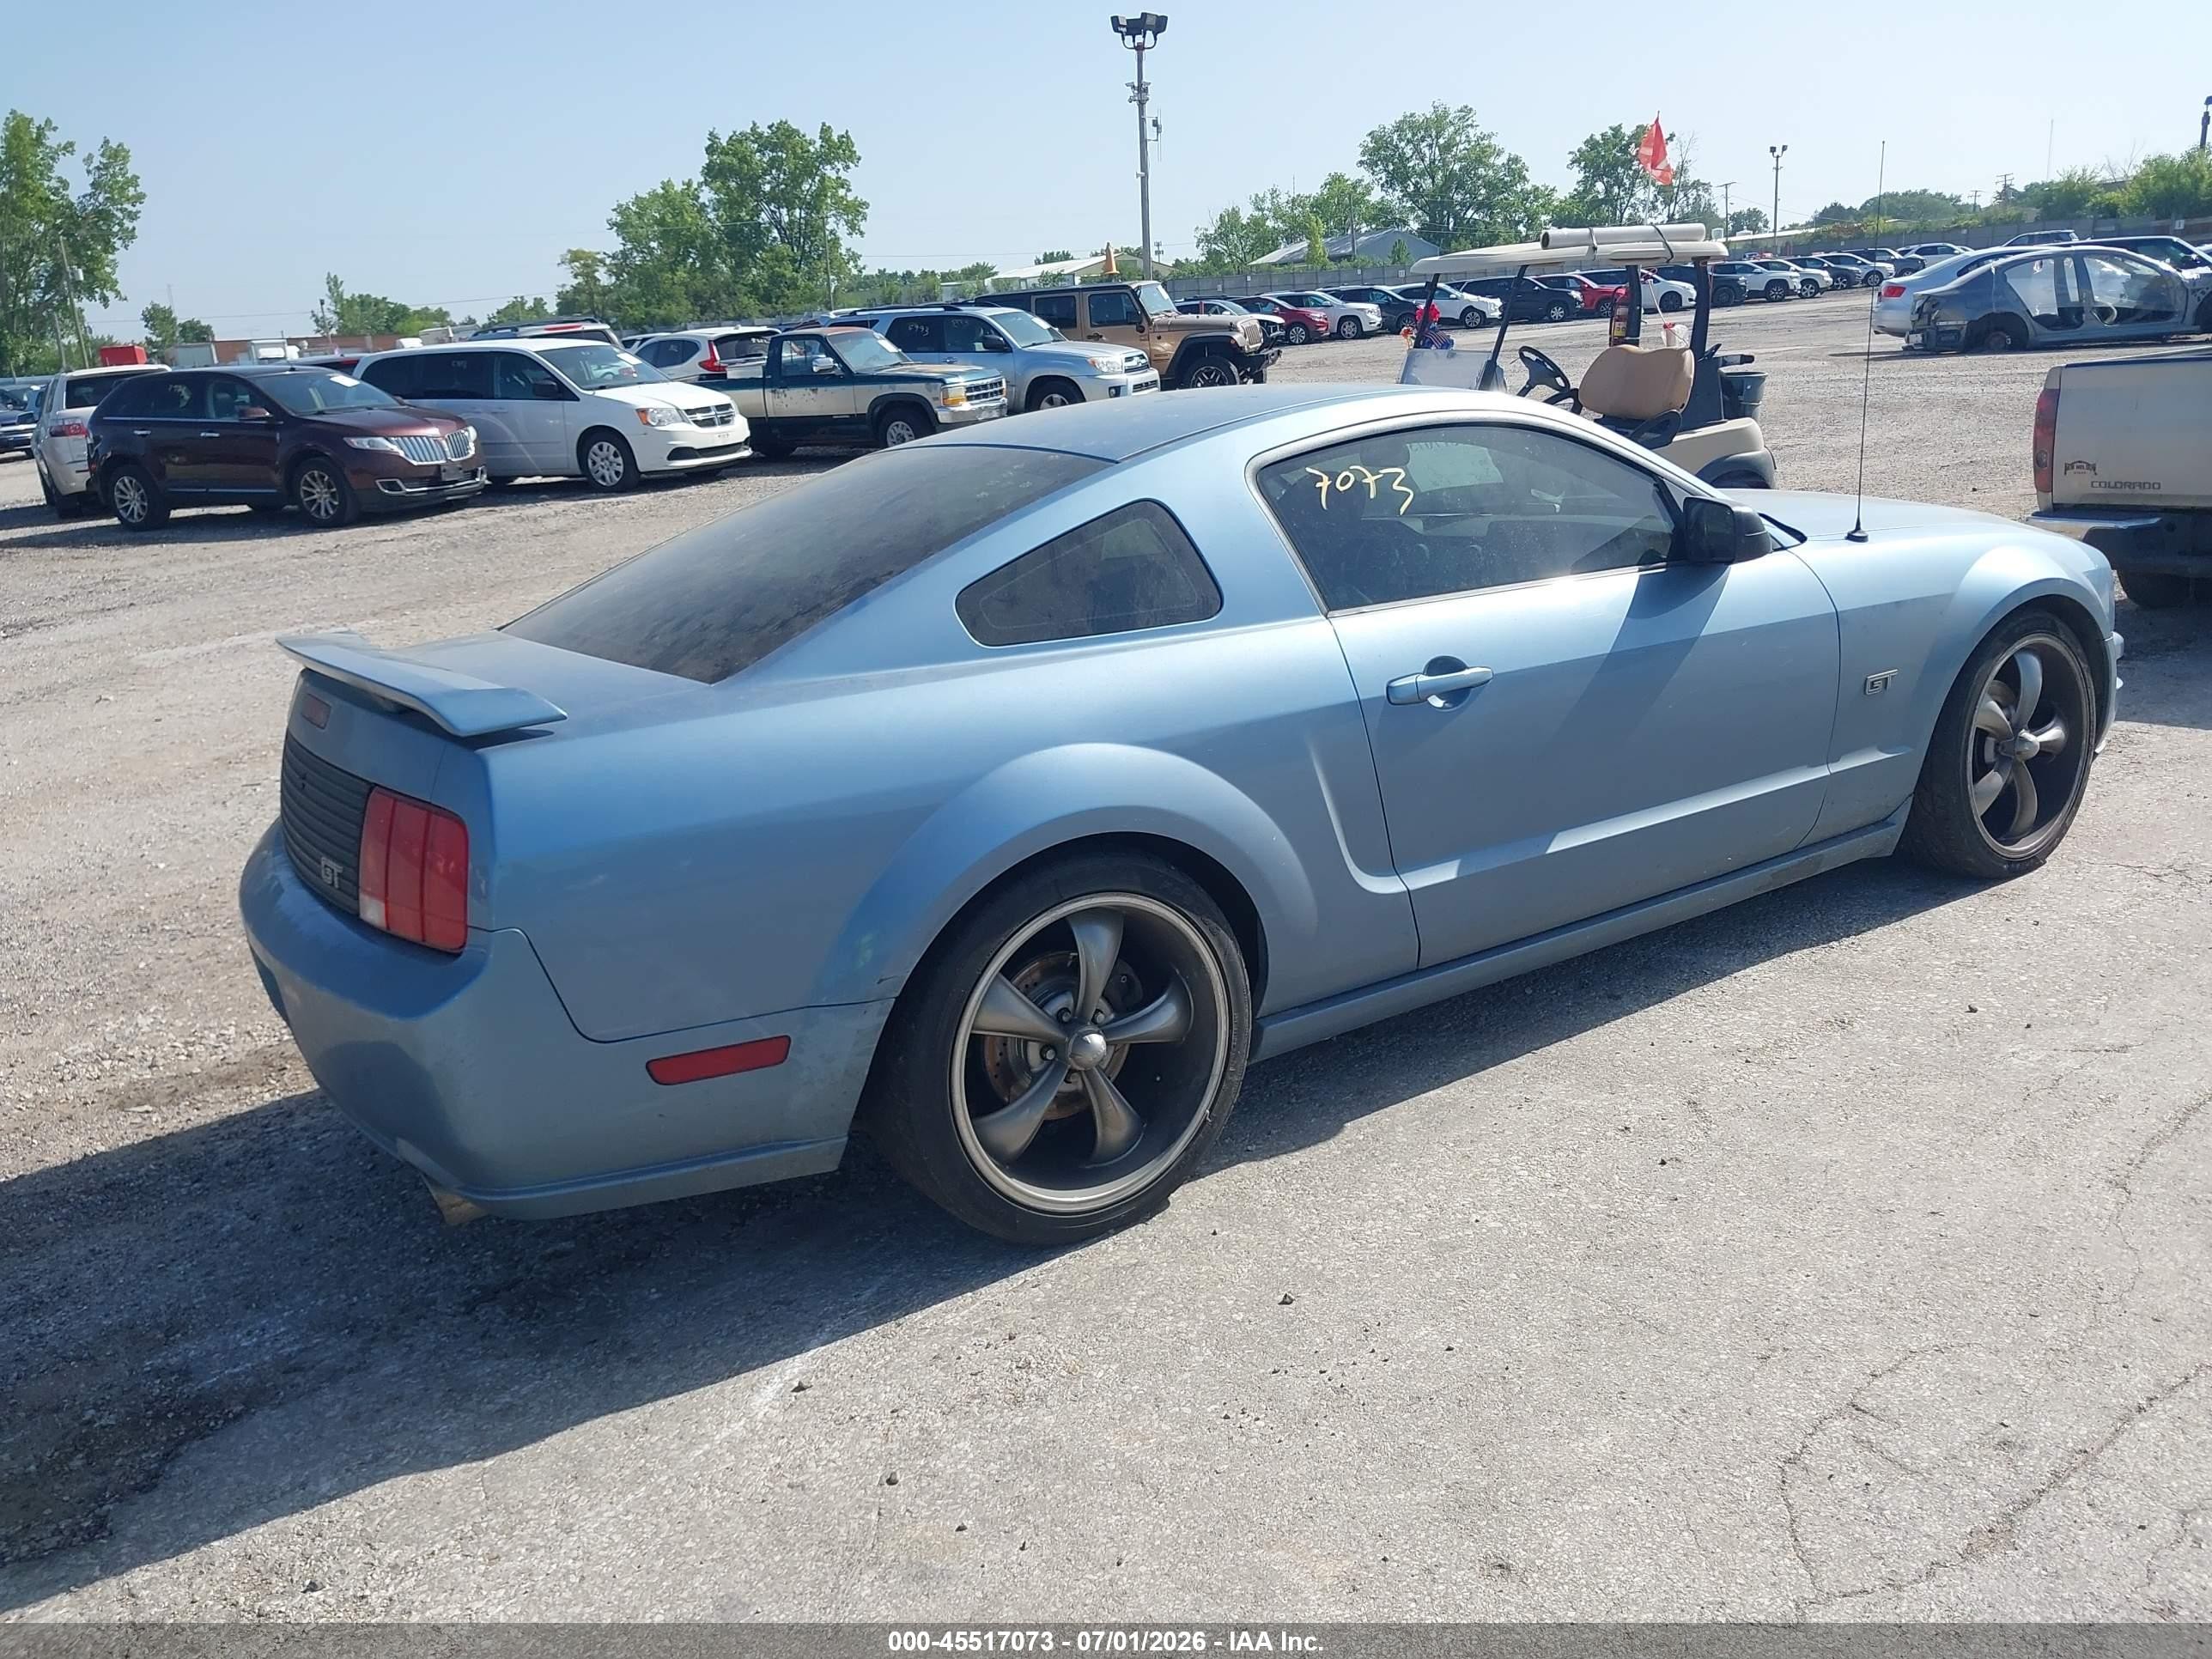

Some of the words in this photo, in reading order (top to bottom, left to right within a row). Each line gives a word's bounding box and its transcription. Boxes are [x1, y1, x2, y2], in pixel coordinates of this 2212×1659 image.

[1305, 465, 1414, 515] 7073
[2091, 481, 2161, 489] COLORADO
[1864, 669, 1899, 696] GT
[321, 857, 343, 889] GT
